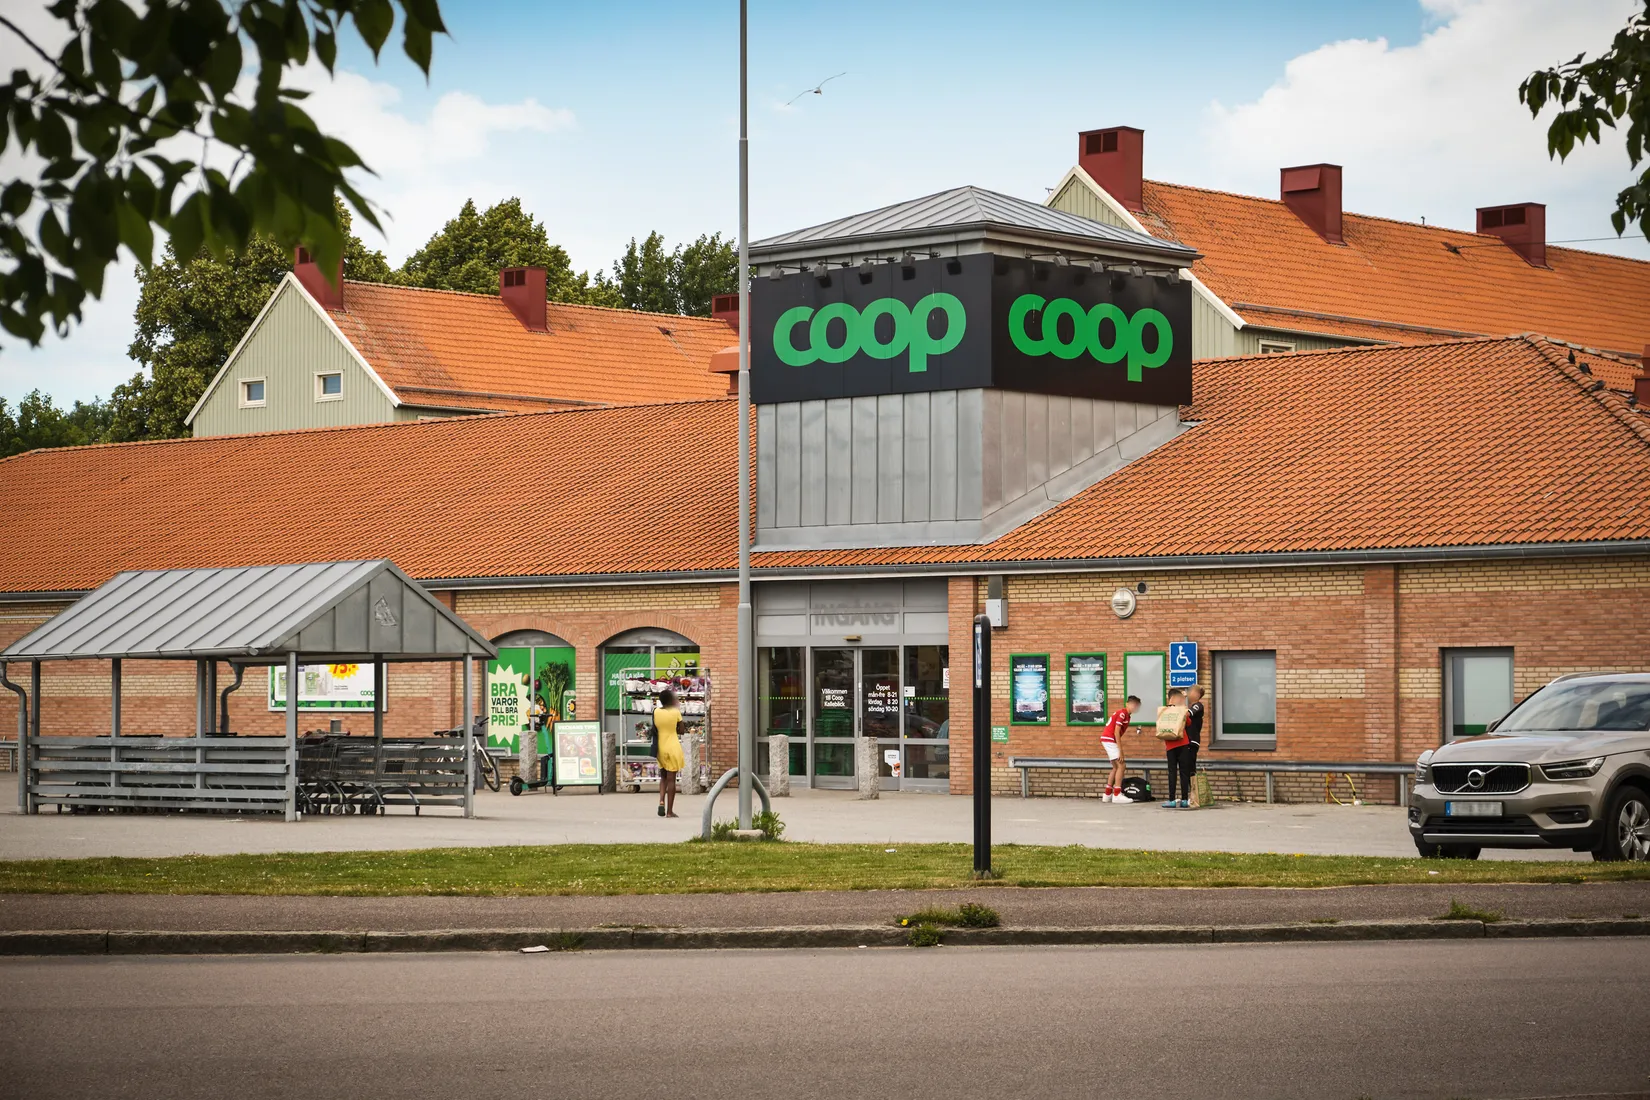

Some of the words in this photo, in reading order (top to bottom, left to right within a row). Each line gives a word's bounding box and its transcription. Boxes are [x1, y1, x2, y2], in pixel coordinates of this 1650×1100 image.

[773, 292, 967, 372] coop
[1008, 293, 1173, 382] coop
[814, 599, 895, 626] INGÅNG
[492, 683, 517, 696] BRA
[492, 715, 518, 726] PRIS!
